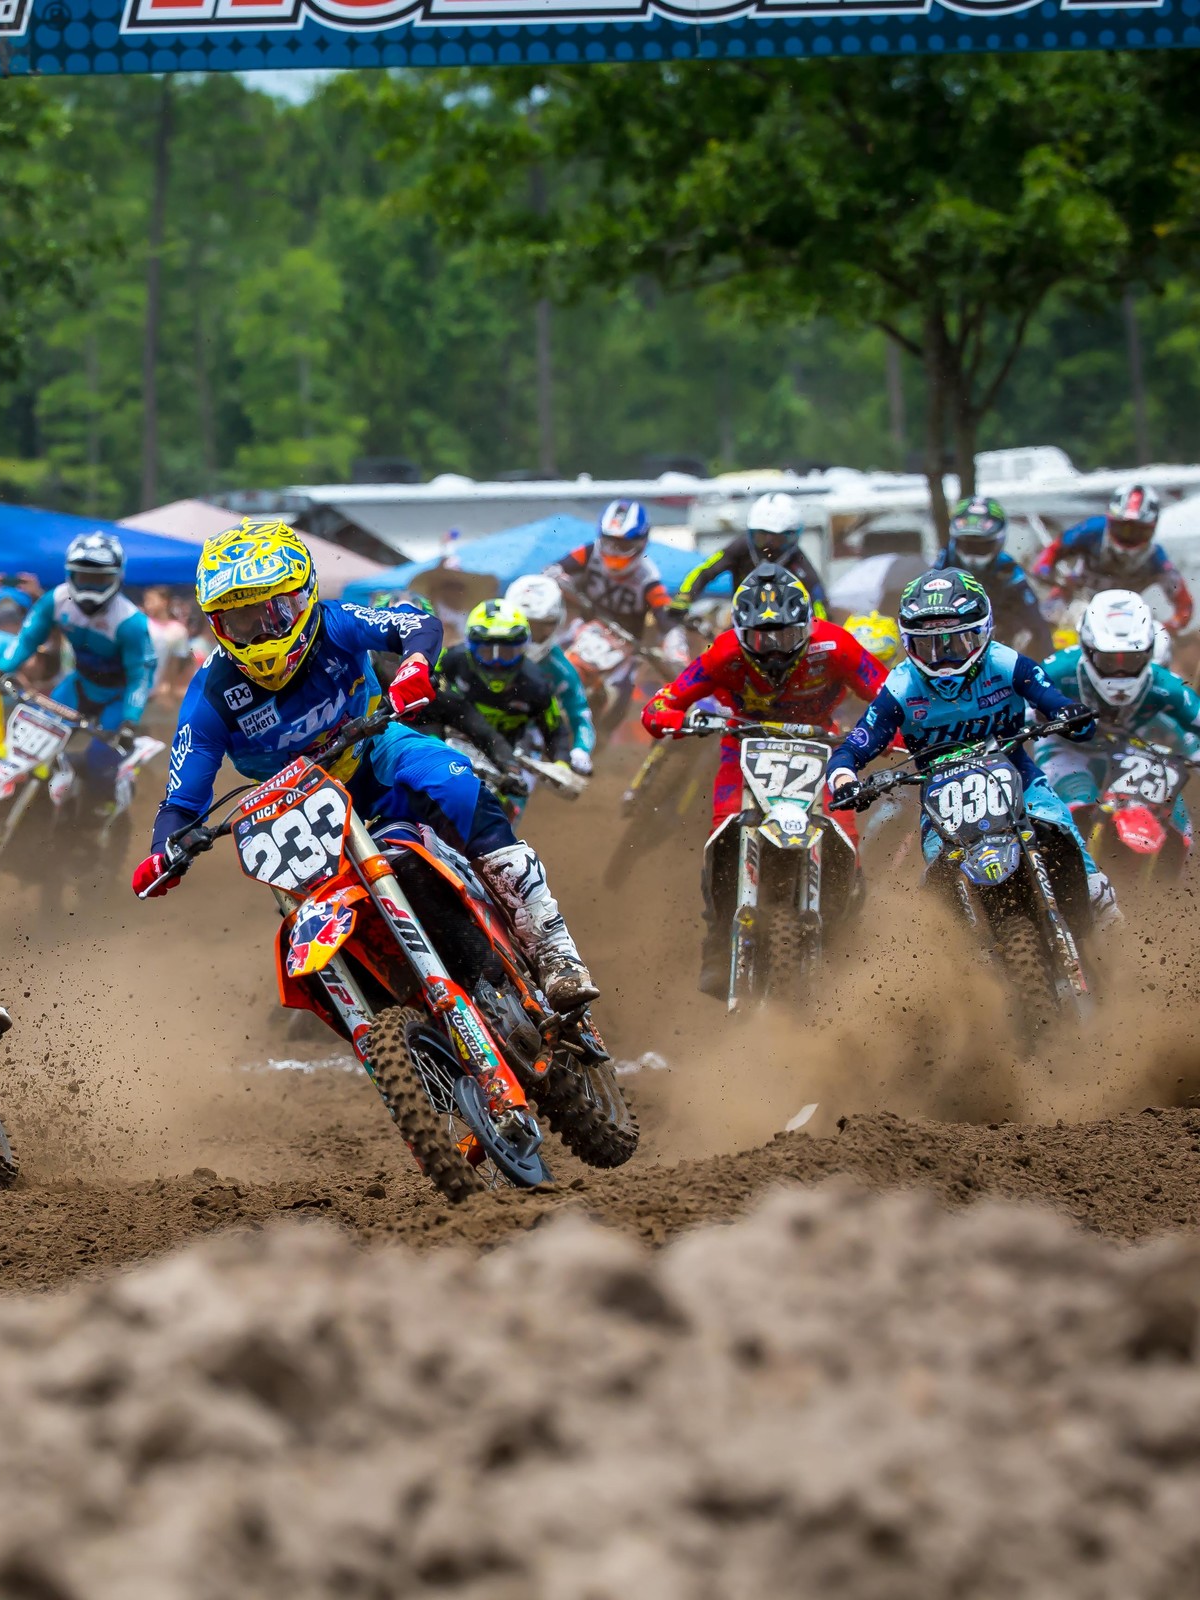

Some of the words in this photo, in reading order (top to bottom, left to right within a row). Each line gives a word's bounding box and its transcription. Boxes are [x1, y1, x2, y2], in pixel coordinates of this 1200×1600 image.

[754, 752, 823, 801] 52
[938, 768, 1013, 835] 936
[242, 787, 347, 892] 233
[461, 1007, 486, 1044] MOTOREX
